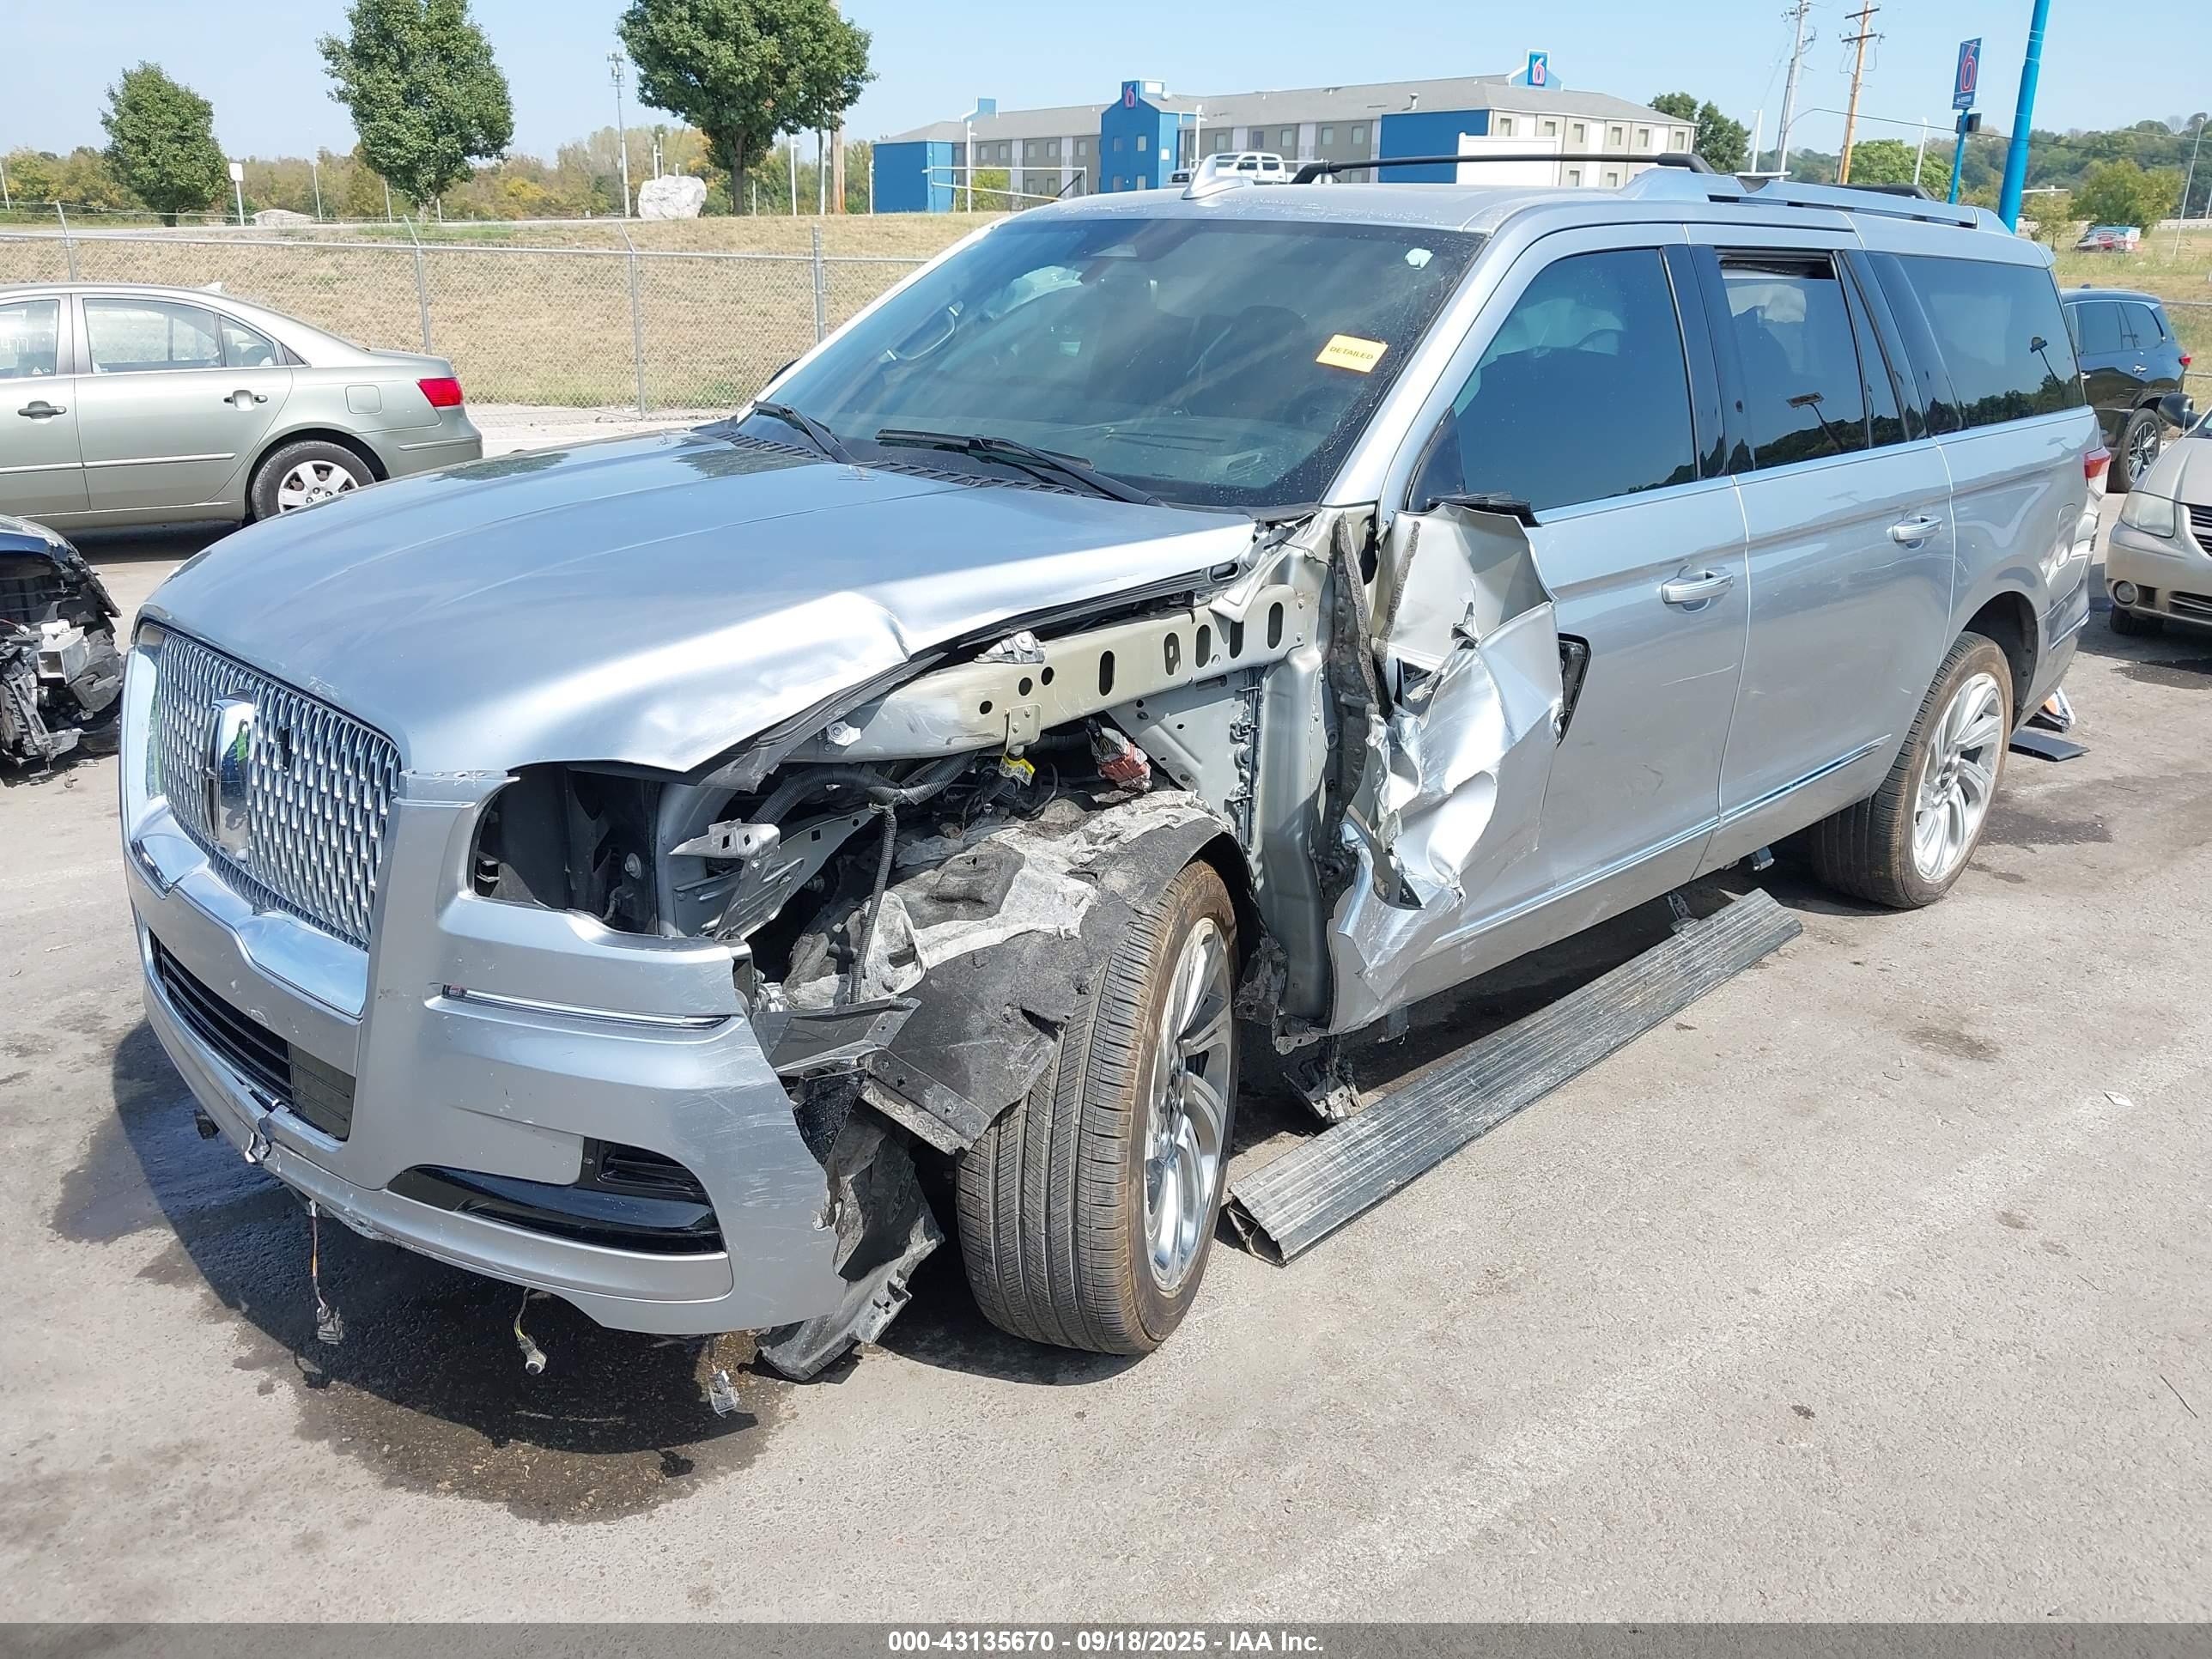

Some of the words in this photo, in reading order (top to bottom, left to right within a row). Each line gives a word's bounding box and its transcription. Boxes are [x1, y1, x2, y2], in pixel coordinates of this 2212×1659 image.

[1532, 57, 1546, 85] 6
[1960, 40, 1978, 93] 6
[1125, 84, 1135, 109] 6
[1329, 346, 1374, 360] DETAILED
